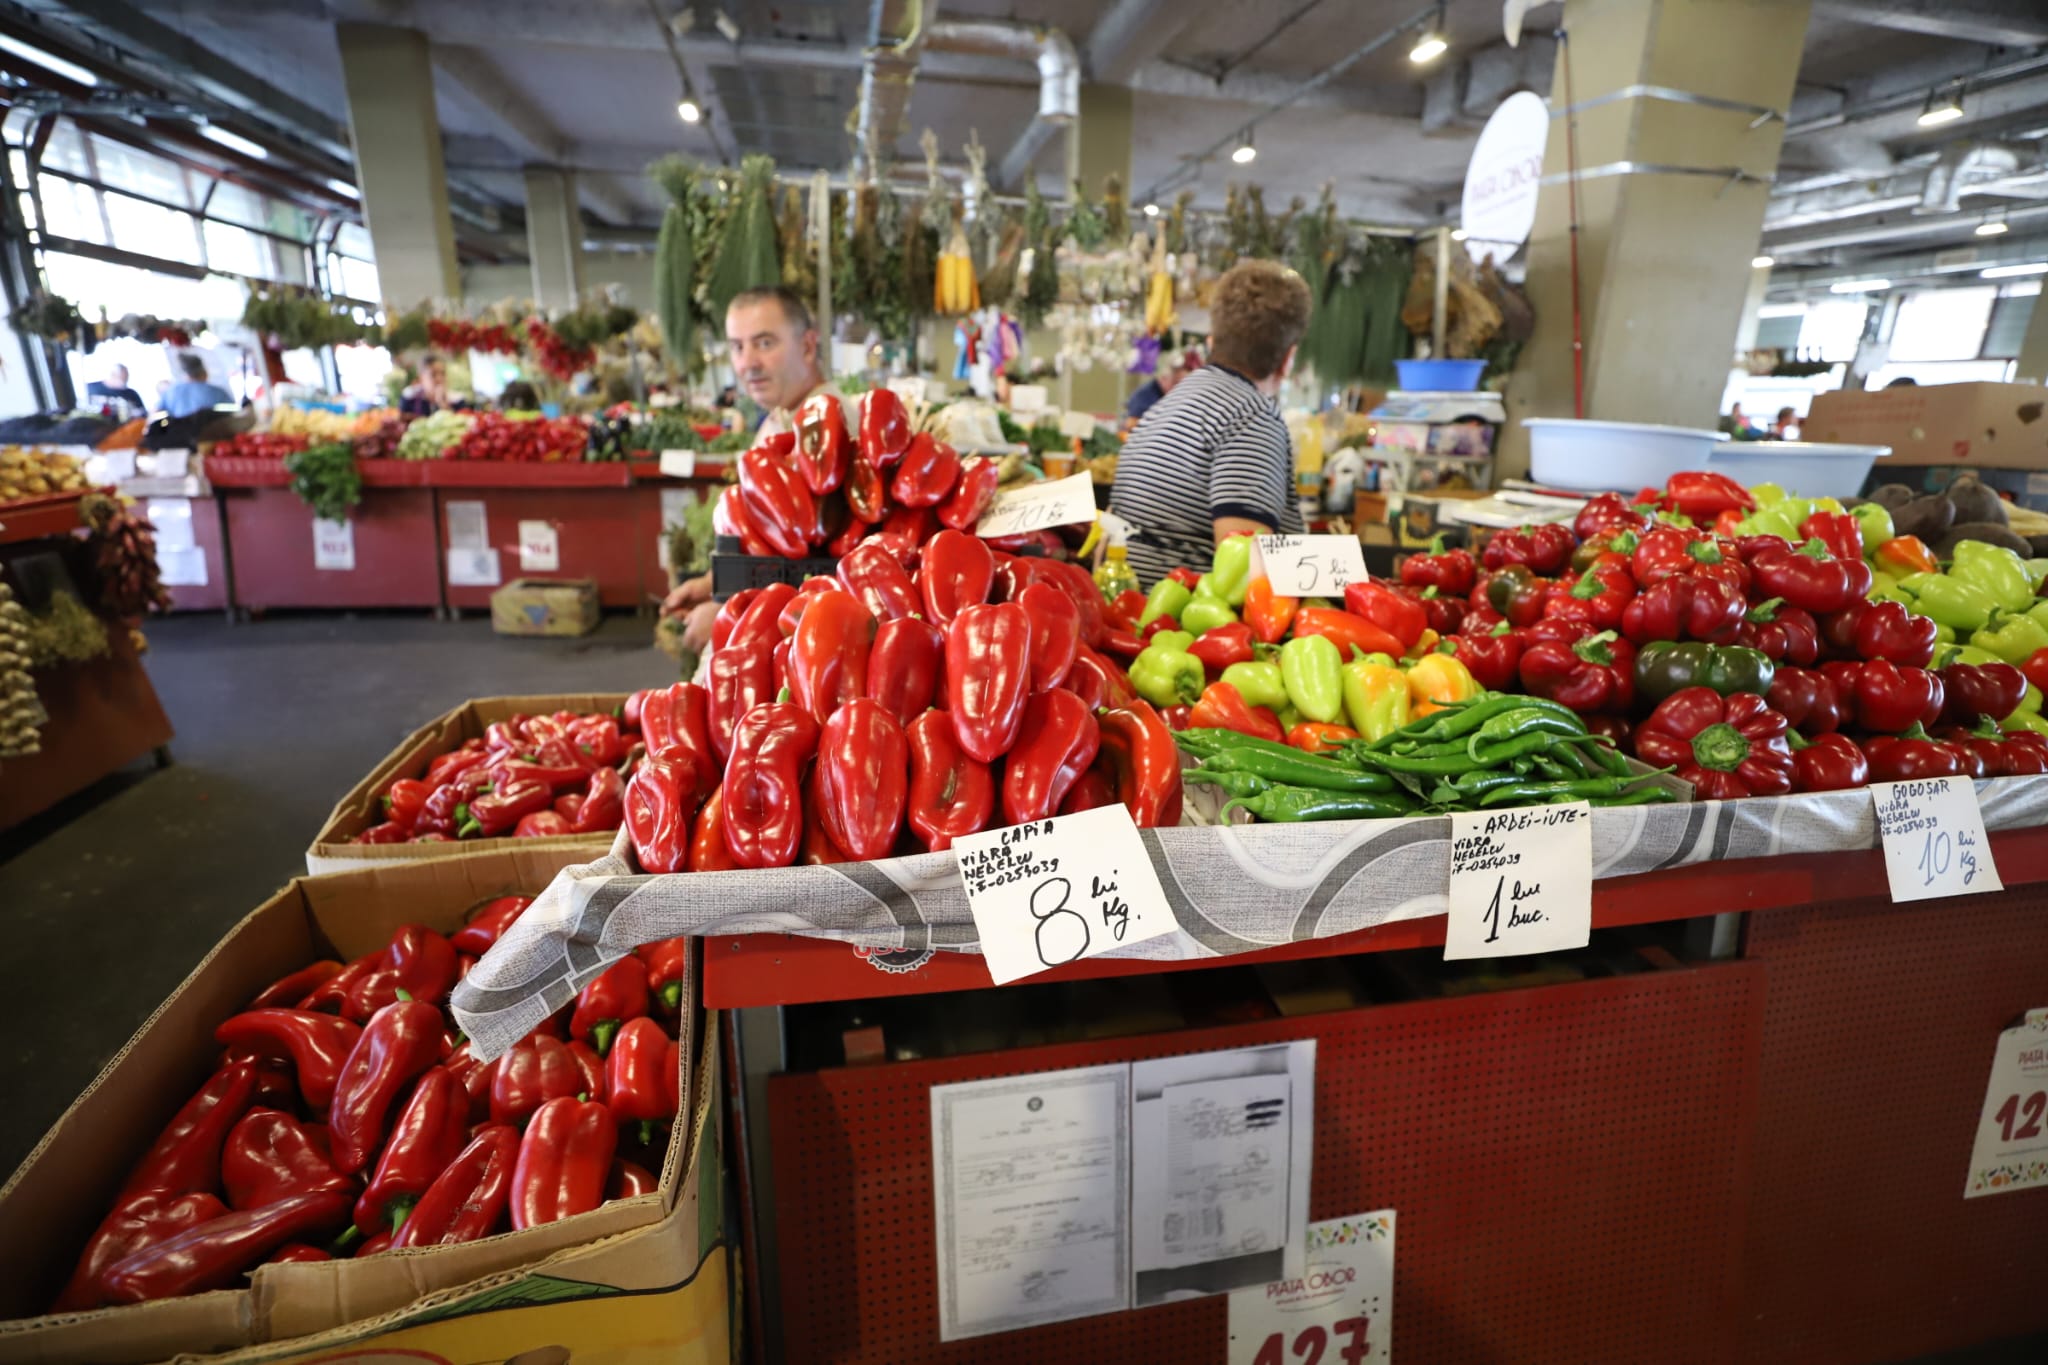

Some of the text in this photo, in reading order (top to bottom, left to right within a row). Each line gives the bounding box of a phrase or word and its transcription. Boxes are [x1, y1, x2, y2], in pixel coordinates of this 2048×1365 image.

[1297, 554, 1319, 592] 5
[1918, 831, 1951, 887] 10
[1029, 869, 1118, 967] 8 lei
[1483, 875, 1541, 943] 1 leu
[1994, 1090, 2048, 1142] 12
